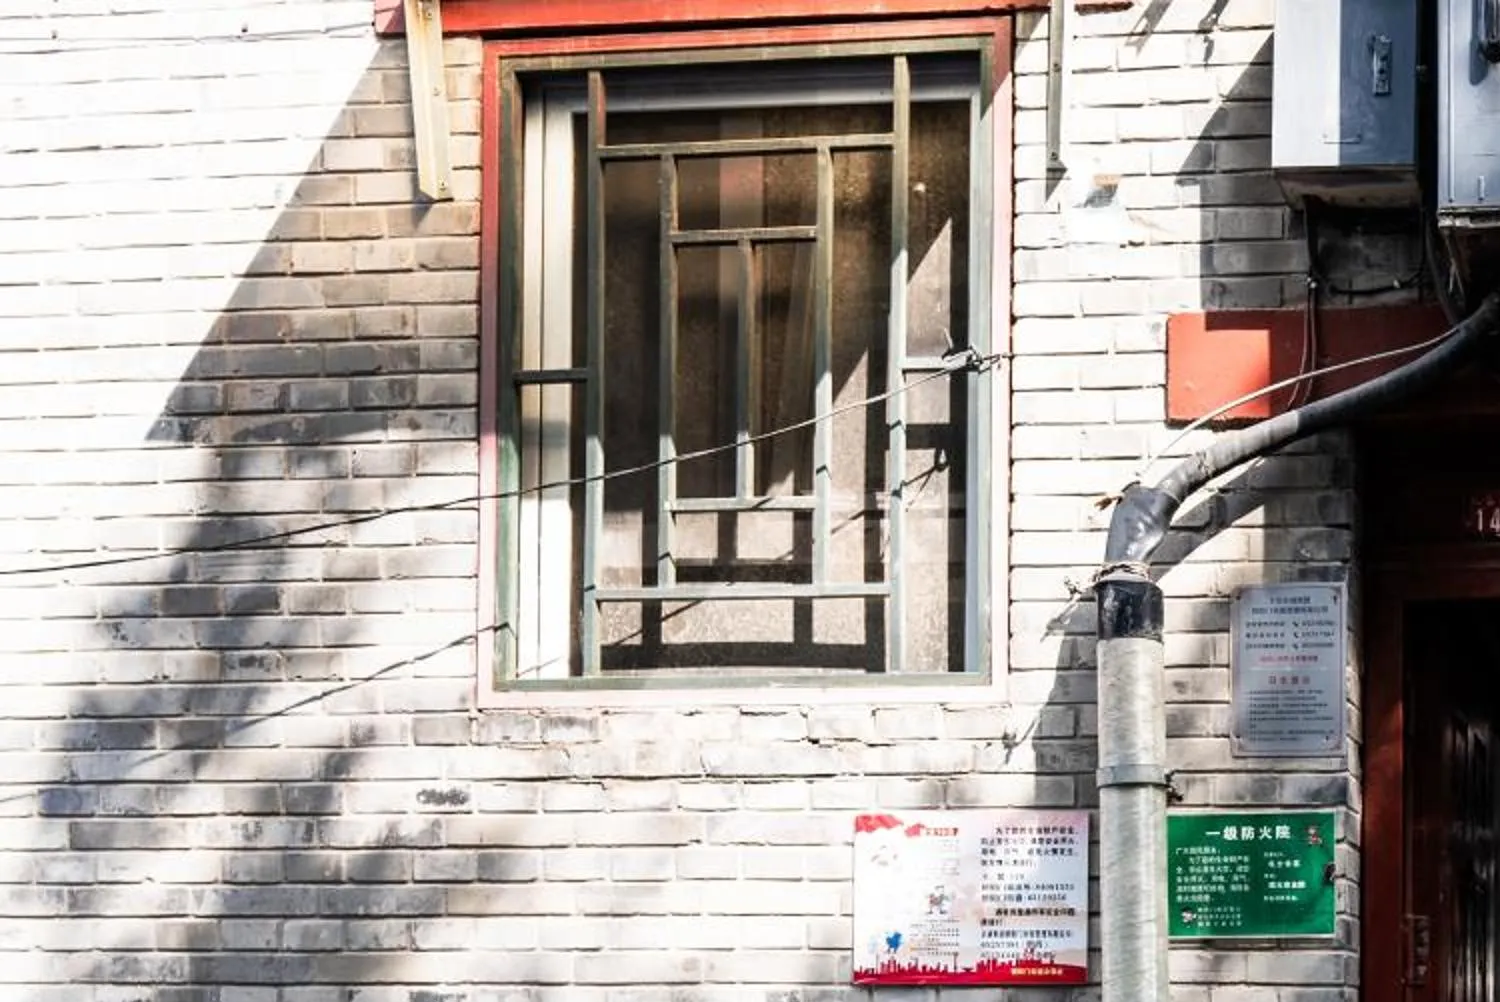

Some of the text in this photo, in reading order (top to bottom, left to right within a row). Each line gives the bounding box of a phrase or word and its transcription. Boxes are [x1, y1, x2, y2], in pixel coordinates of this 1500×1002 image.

[1205, 825, 1291, 841] 一级防火院
